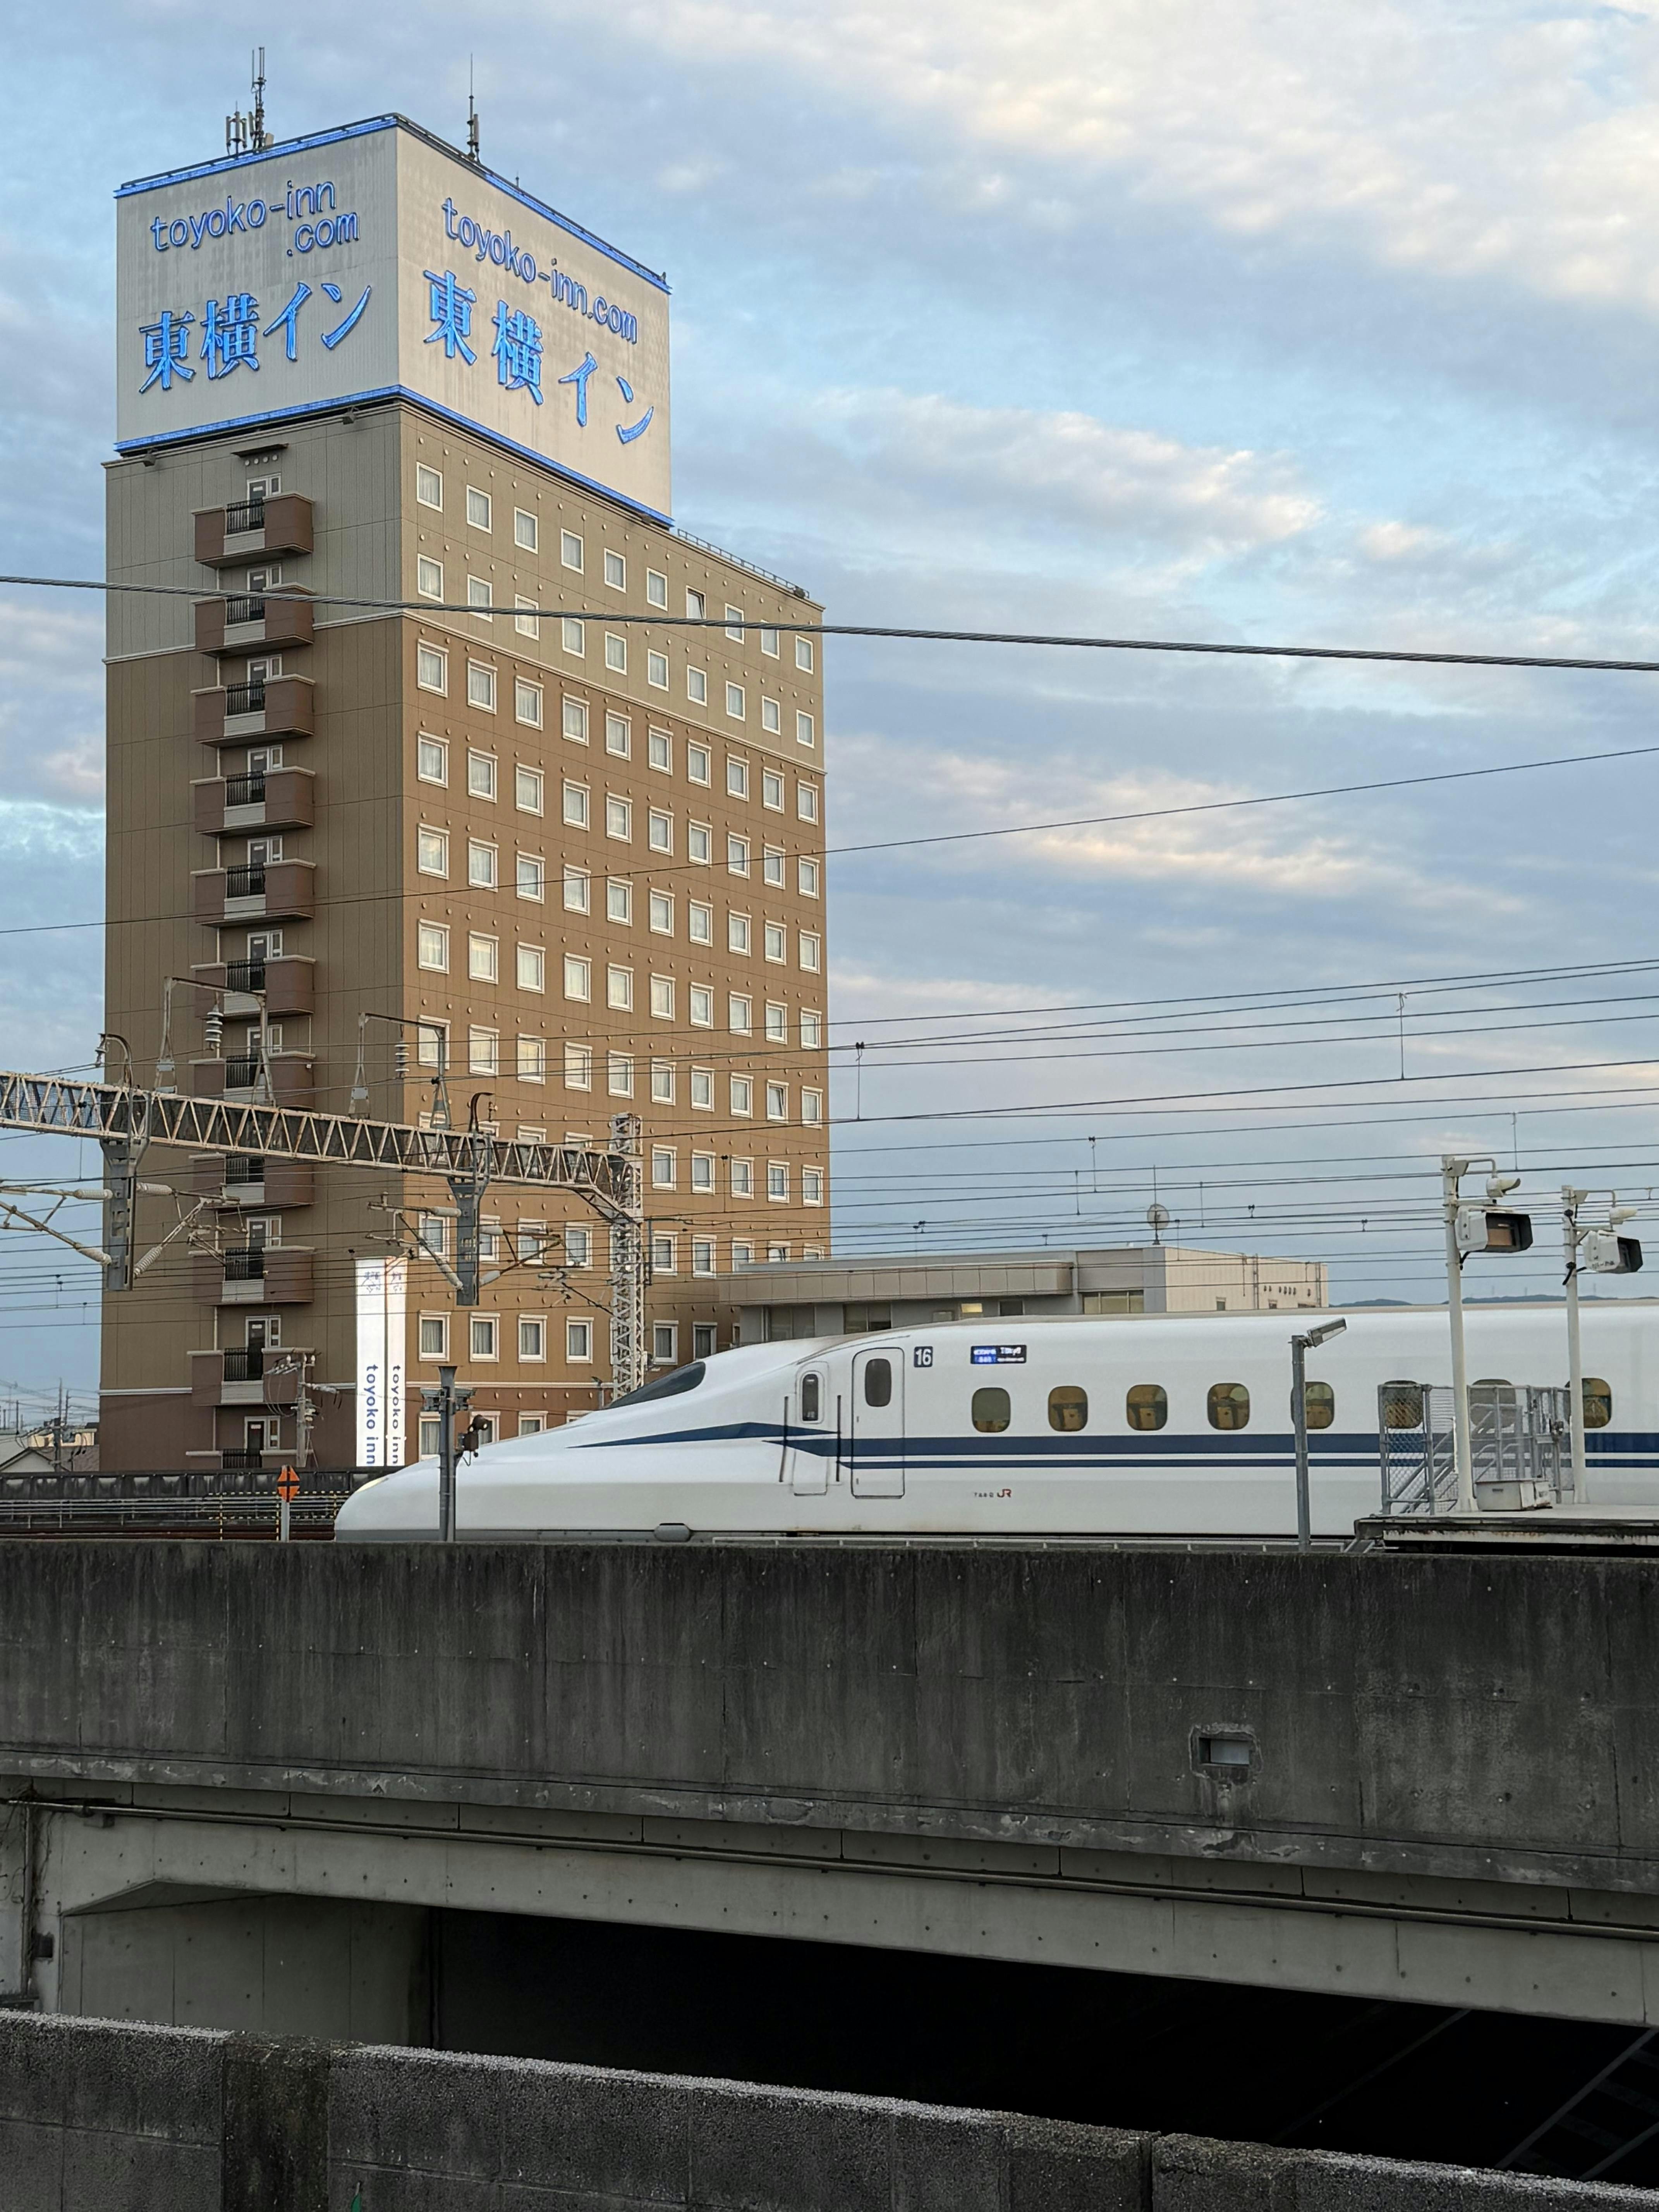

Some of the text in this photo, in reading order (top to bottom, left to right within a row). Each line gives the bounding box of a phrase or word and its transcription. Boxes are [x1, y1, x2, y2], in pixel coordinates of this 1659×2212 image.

[151, 180, 336, 251] toyoko-inn
[287, 211, 359, 256] .com
[441, 198, 637, 344] toyoko-inn.com
[139, 282, 371, 394] 東横イン
[423, 270, 654, 444] 東横イン
[915, 1348, 931, 1365] 16
[364, 1364, 379, 1465] toyoko inn
[391, 1365, 401, 1464] toyoko inn
[997, 1489, 1012, 1498] JR
